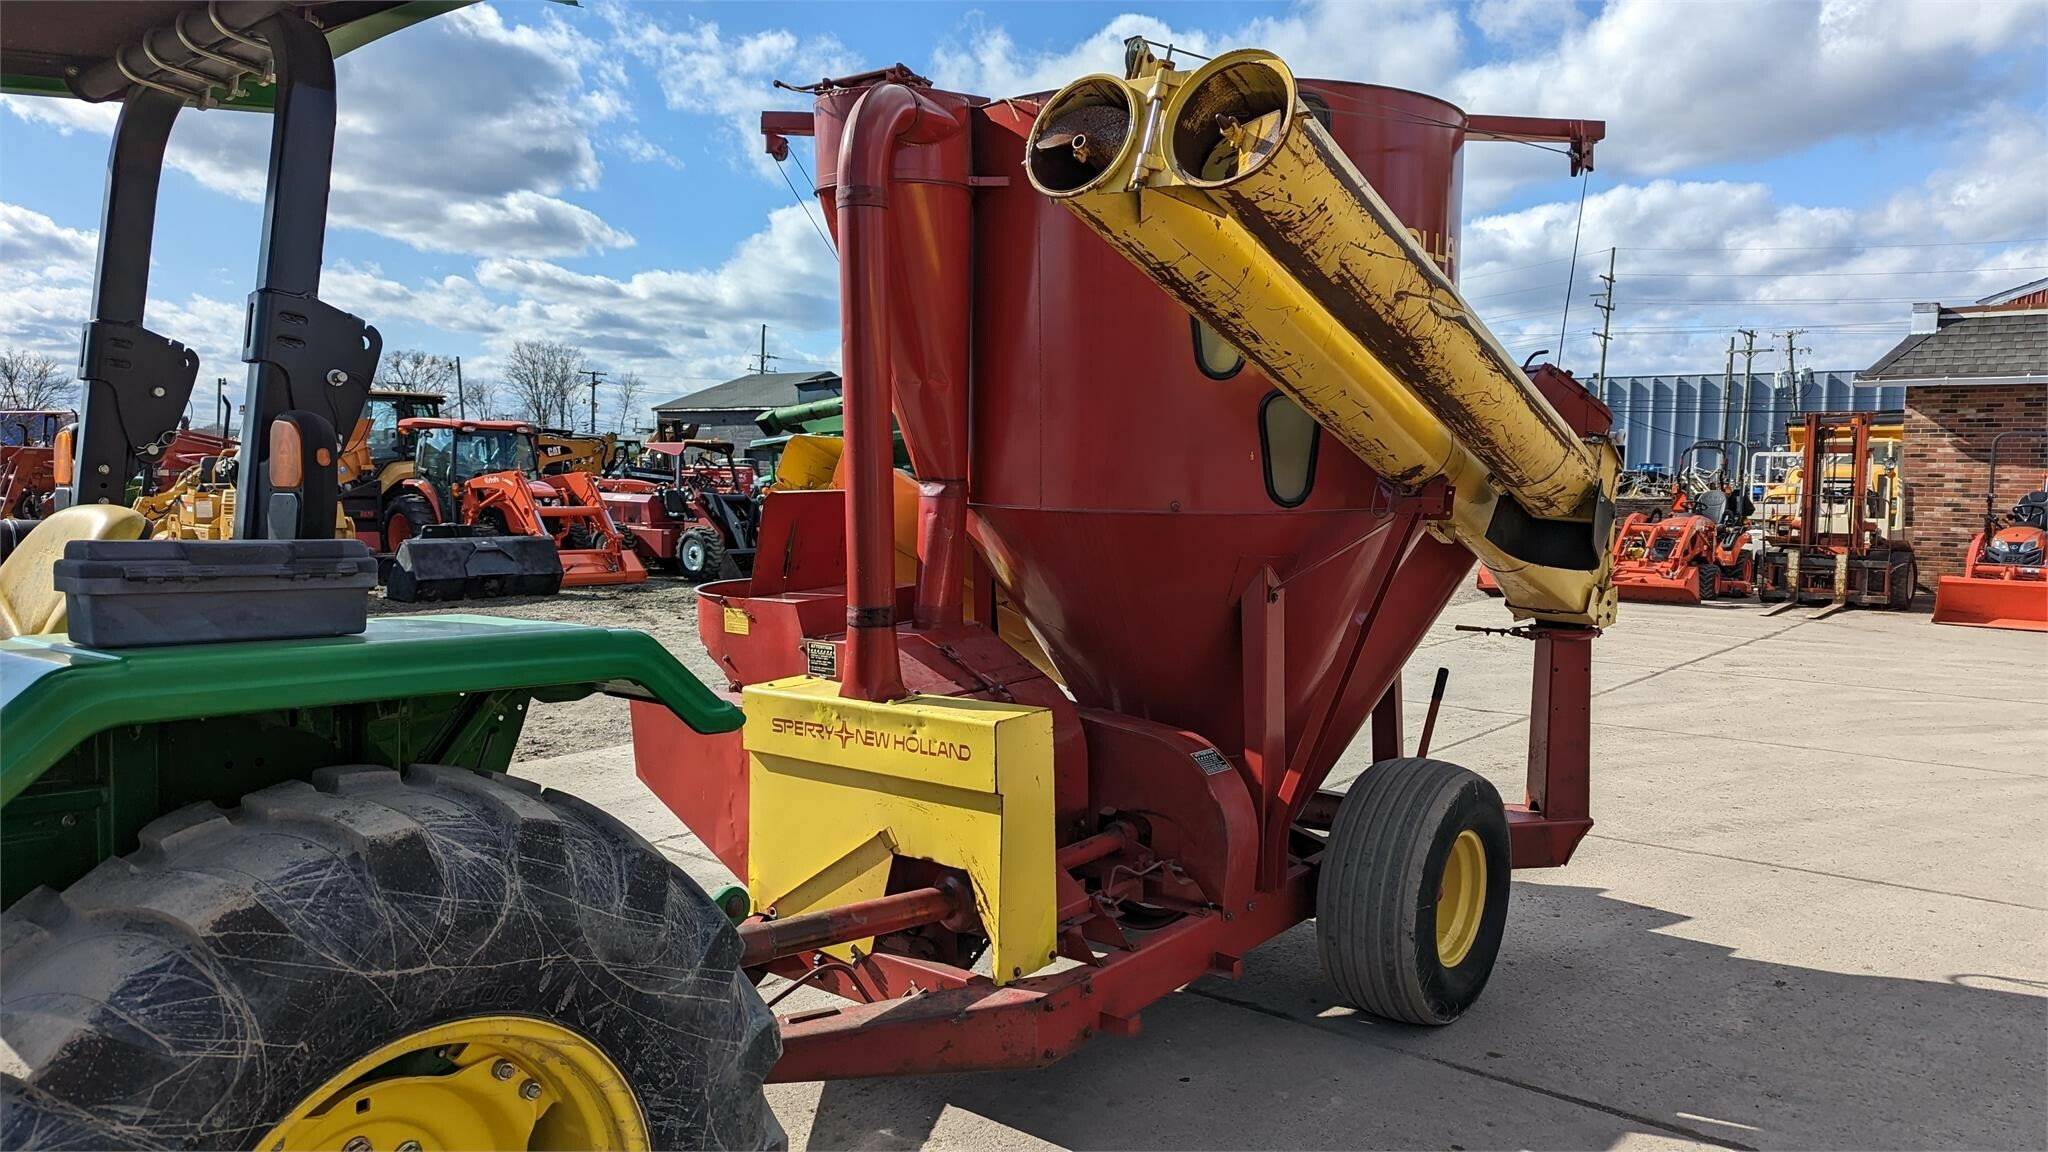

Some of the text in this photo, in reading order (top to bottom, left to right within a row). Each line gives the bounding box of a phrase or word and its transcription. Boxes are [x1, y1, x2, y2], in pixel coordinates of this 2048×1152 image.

[547, 445, 562, 457] CAT
[771, 717, 971, 762] SPERRY NEW HOLLAND
